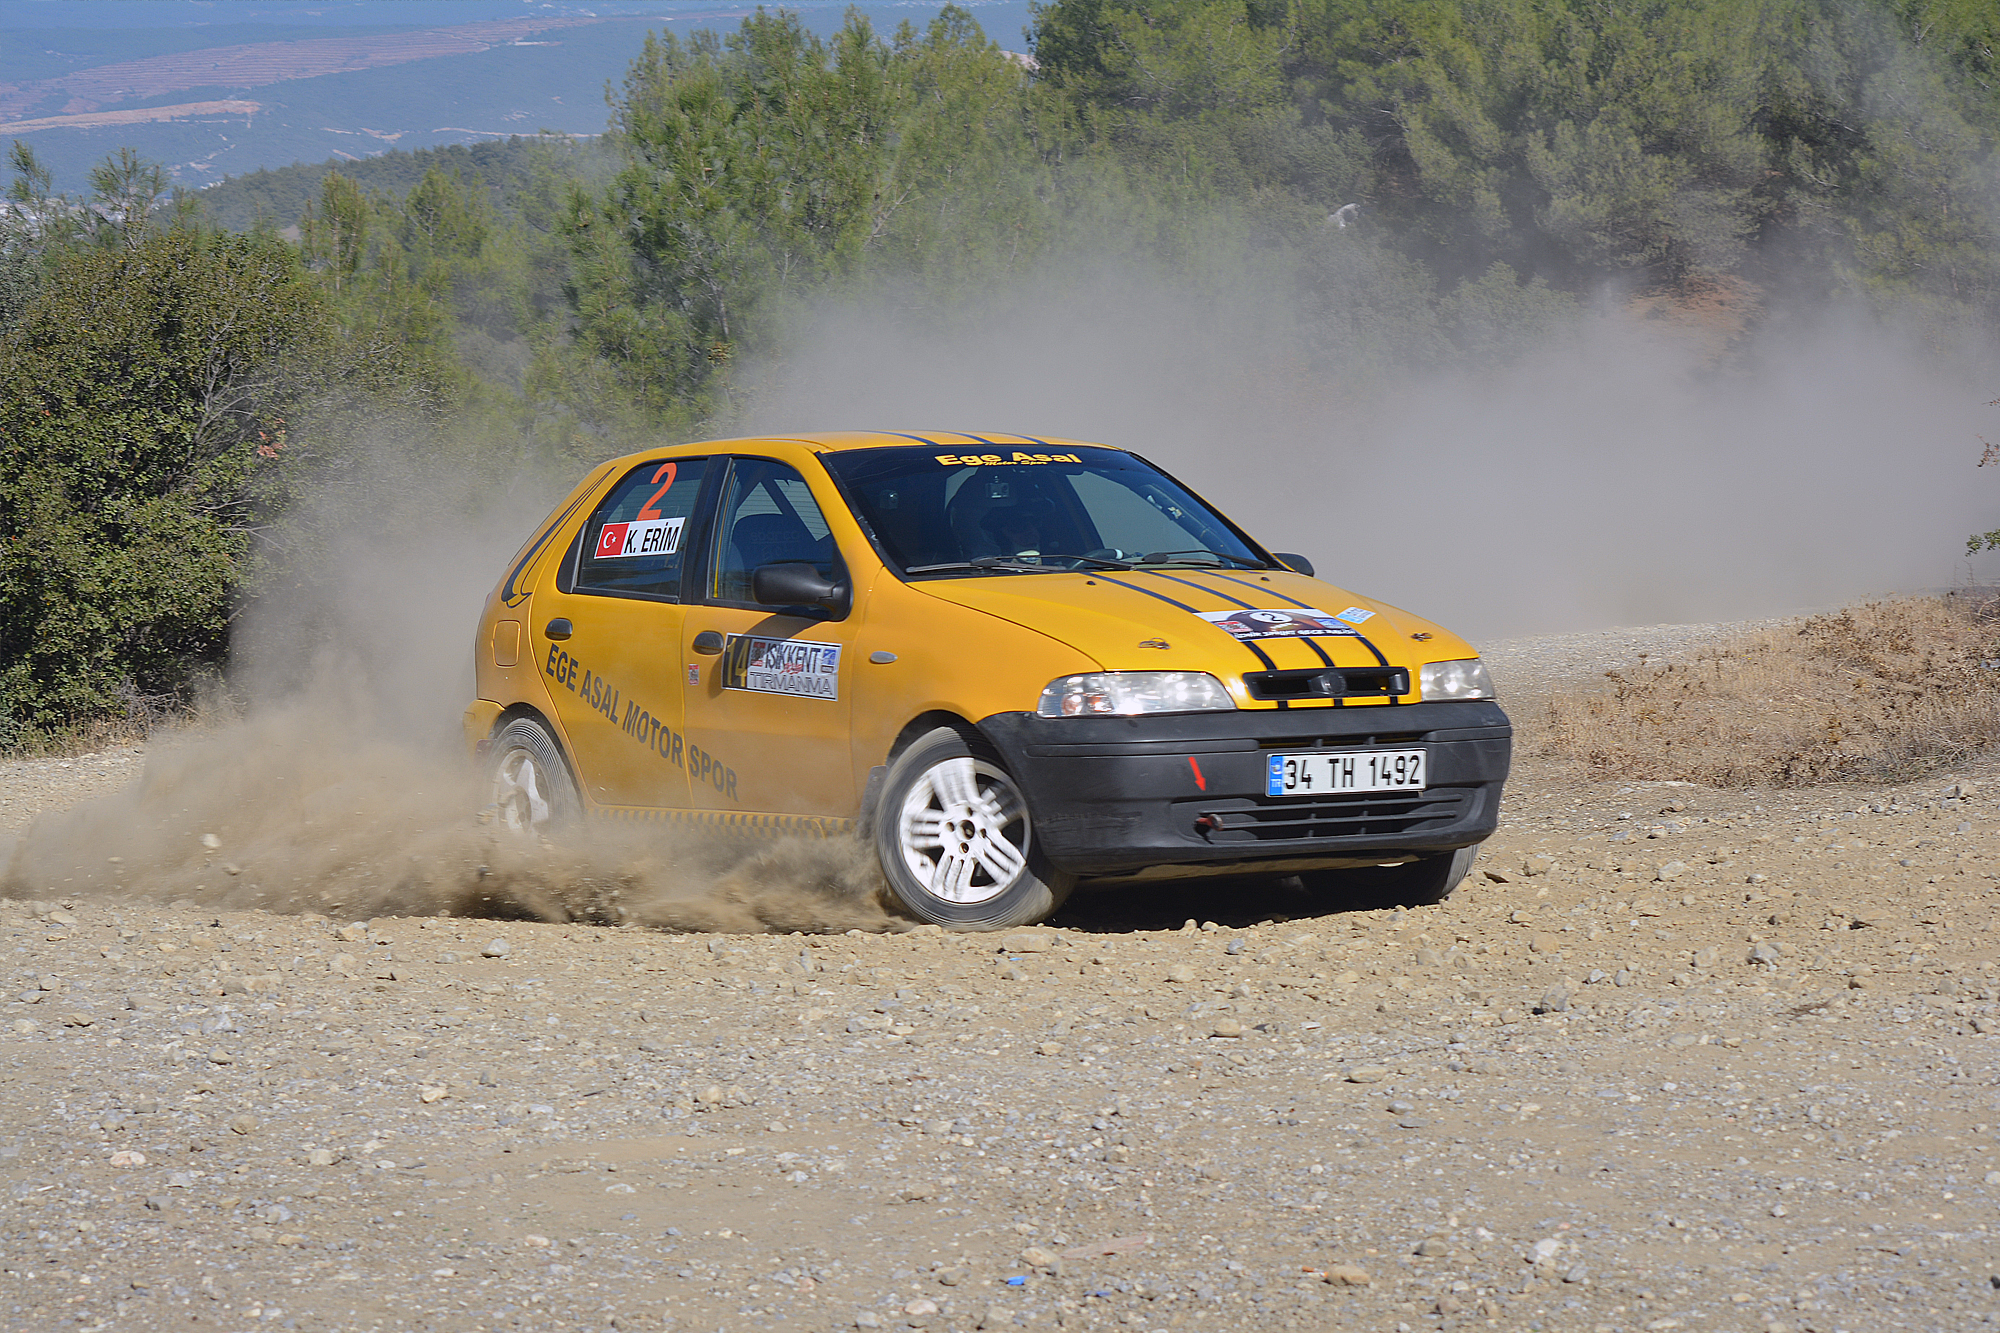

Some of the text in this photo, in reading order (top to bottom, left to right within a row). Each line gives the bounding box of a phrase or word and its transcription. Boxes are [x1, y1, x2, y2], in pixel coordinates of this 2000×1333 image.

[935, 451, 1083, 466] Ege Asal
[636, 462, 678, 521] 2
[624, 522, 679, 554] K. ERİM
[1261, 613, 1284, 622] 2
[727, 637, 751, 687] 14
[546, 642, 739, 803] EGE ASAL MOTOR SPOR
[1284, 755, 1420, 790] 34 TH 1492
